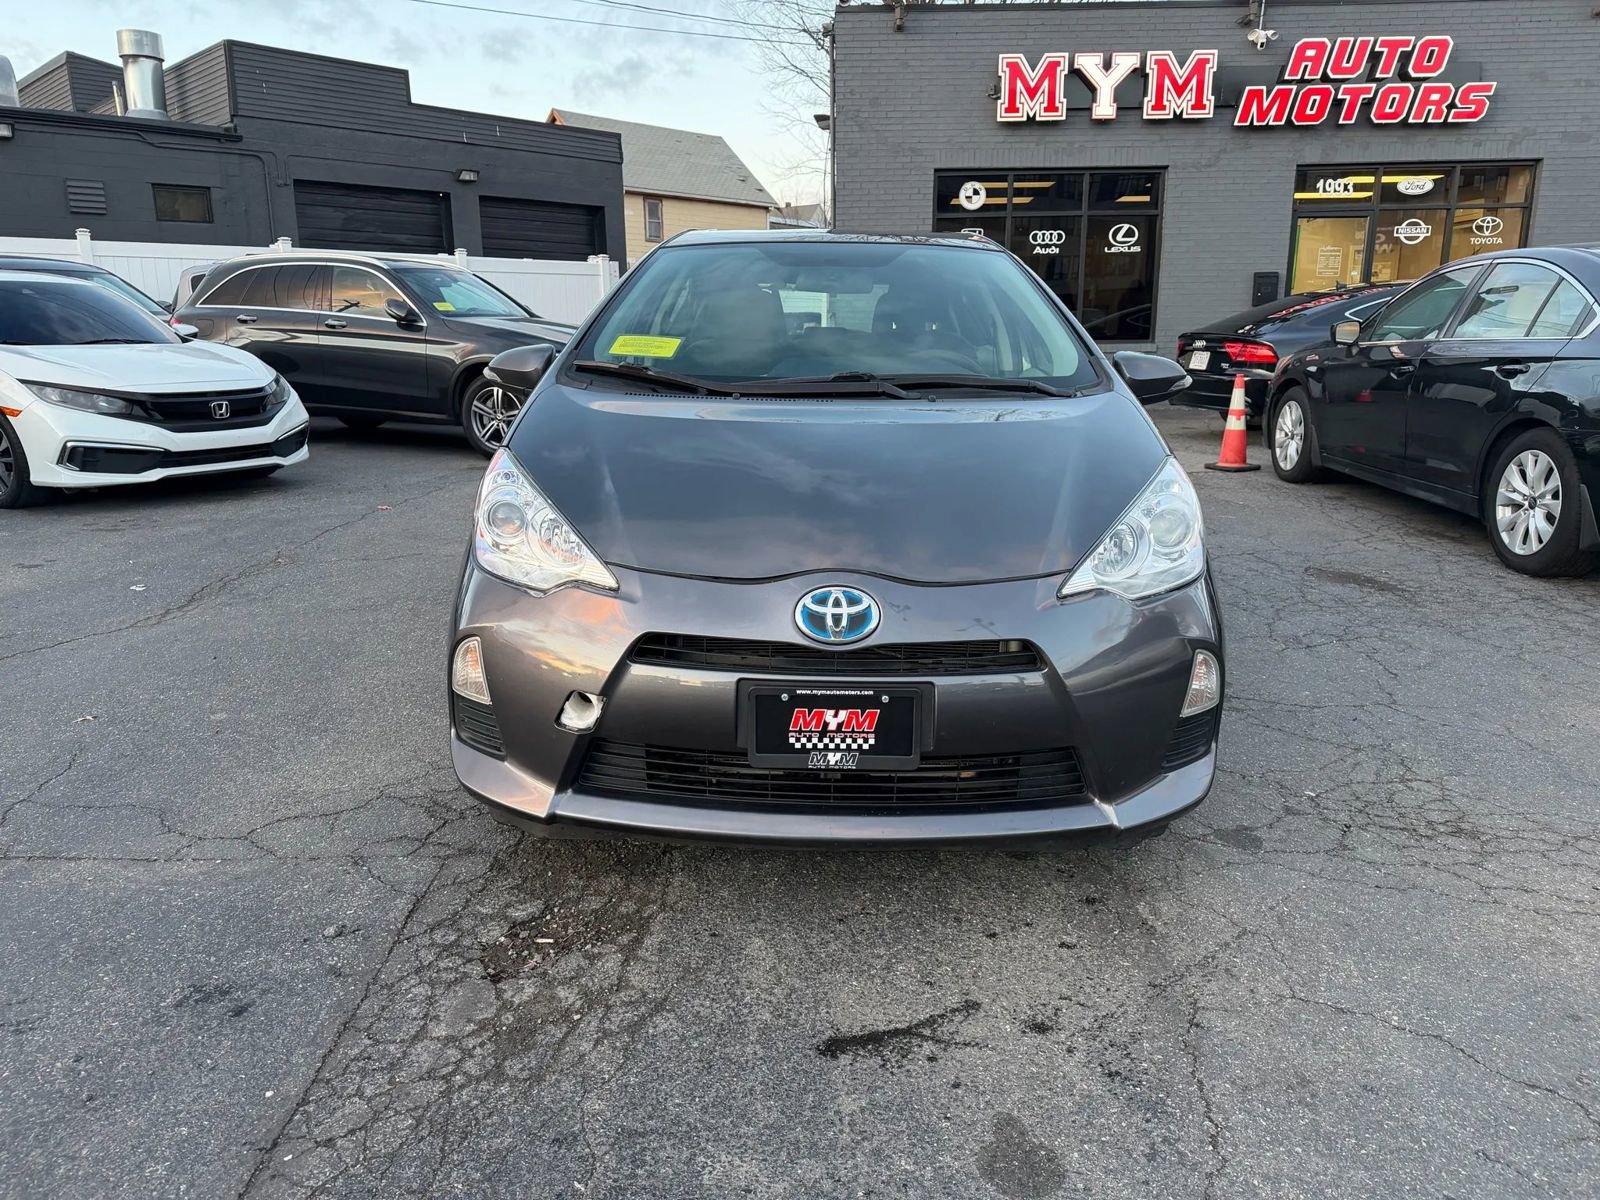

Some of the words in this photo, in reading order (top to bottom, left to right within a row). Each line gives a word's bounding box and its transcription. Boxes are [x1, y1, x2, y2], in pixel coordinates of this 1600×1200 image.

[1284, 36, 1454, 80] AUTO
[997, 49, 1219, 122] MYM
[1233, 81, 1498, 126] MOTORS
[1316, 178, 1354, 195] 1993
[1397, 227, 1428, 235] NISSAN
[1470, 237, 1503, 245] TOYOTA
[1032, 245, 1060, 255] Audi
[1104, 245, 1142, 253] LEXUS
[789, 708, 880, 731] MYM
[808, 752, 859, 765] MYM
